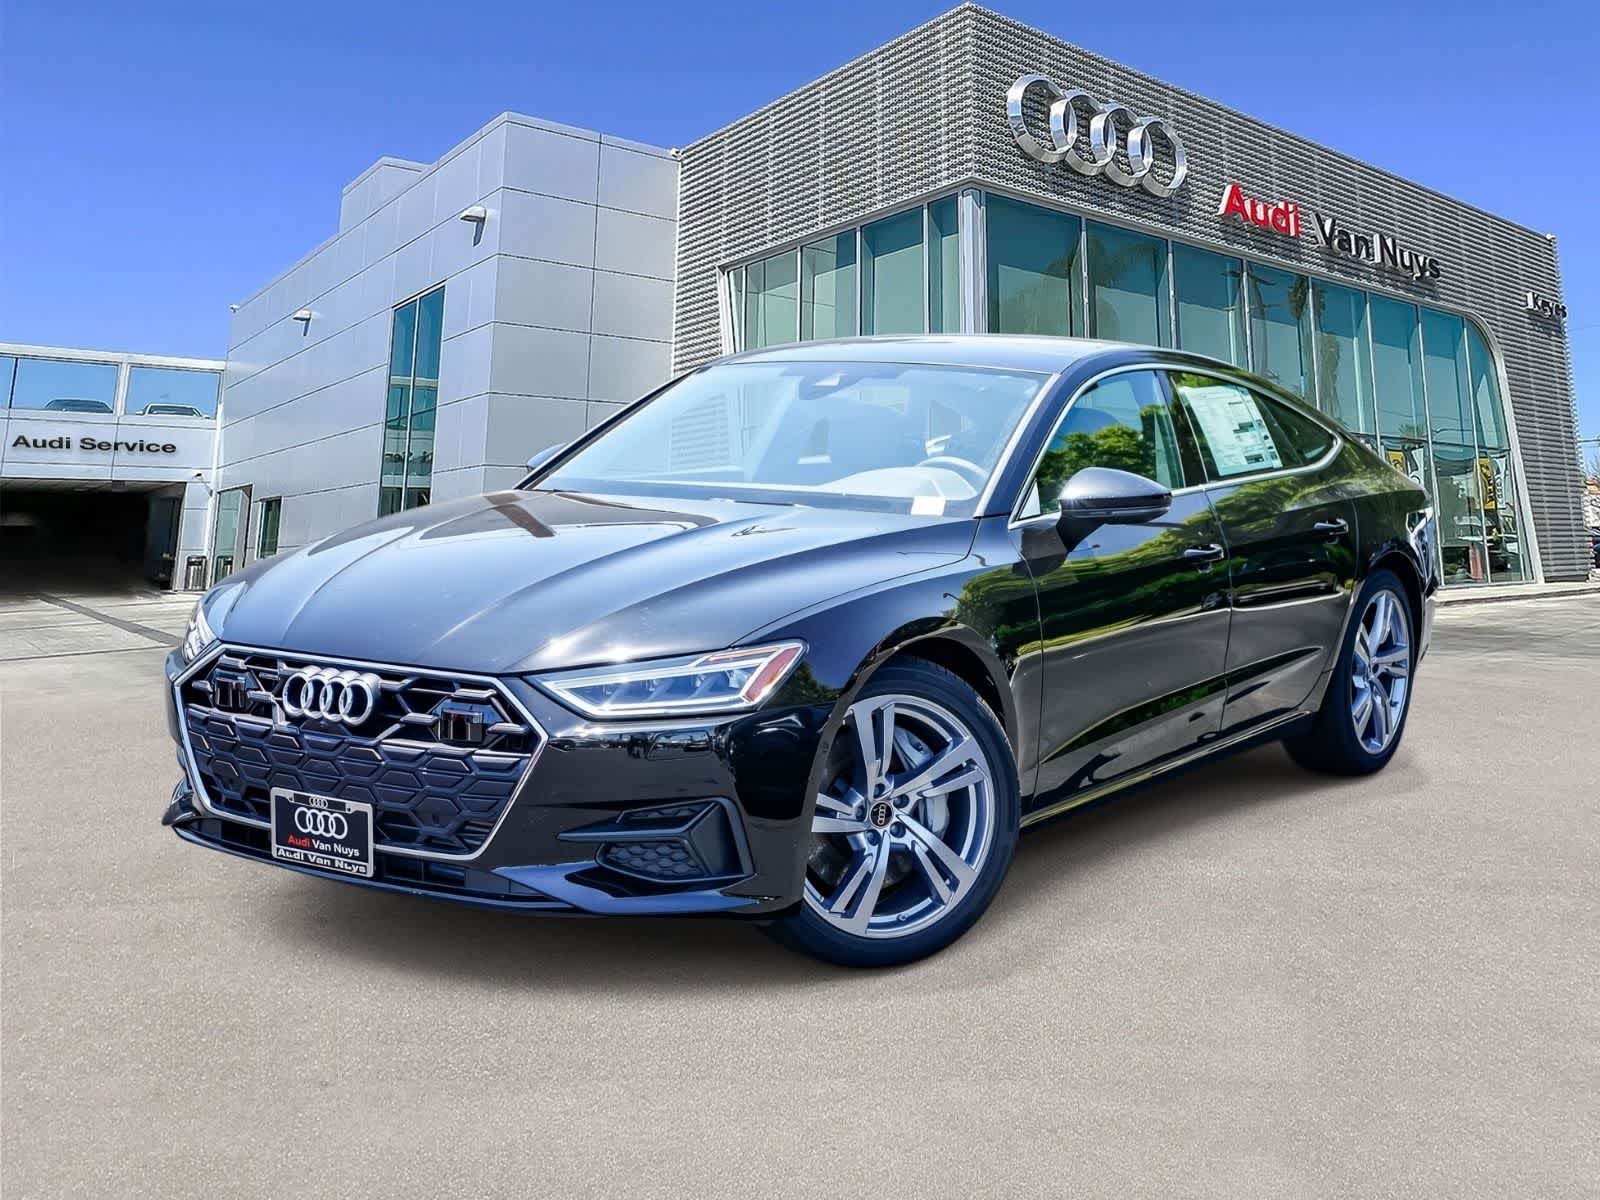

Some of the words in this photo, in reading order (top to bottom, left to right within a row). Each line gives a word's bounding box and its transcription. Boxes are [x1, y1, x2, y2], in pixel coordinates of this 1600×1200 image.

[1218, 183, 1301, 236] Audi
[1311, 212, 1372, 263] Van
[1373, 232, 1441, 281] Nuys
[12, 435, 71, 449] Audi
[79, 437, 177, 453] Service
[288, 835, 310, 847] Audi
[312, 839, 331, 851] Van
[333, 843, 359, 857] Nuys
[278, 849, 304, 860] Audi
[307, 854, 331, 866] Van
[335, 860, 366, 873] Nuys
